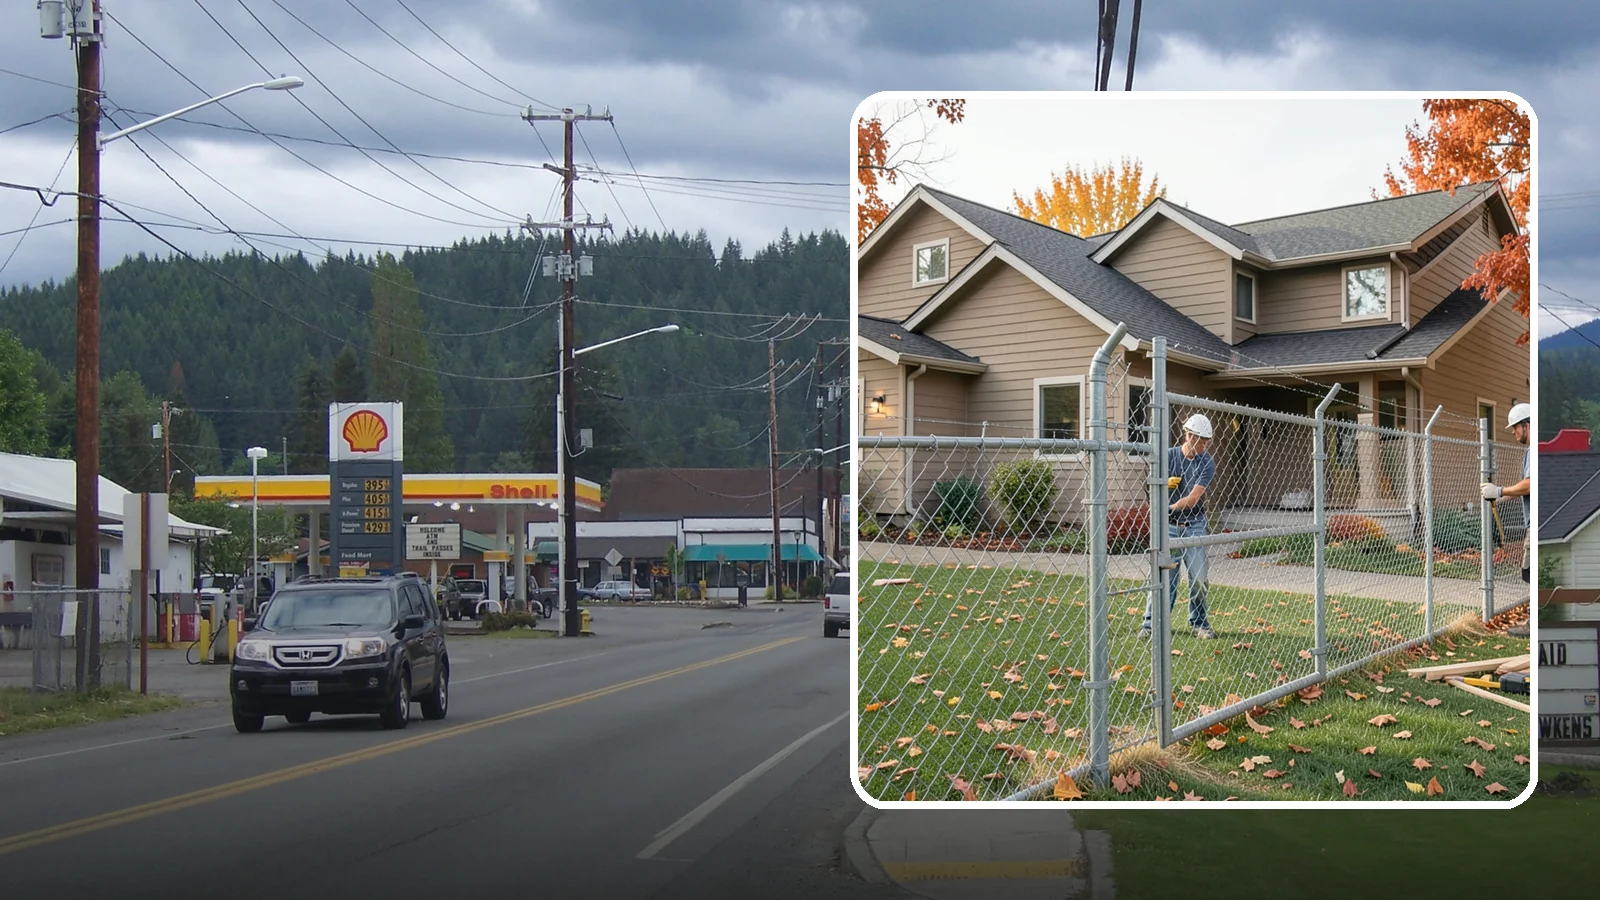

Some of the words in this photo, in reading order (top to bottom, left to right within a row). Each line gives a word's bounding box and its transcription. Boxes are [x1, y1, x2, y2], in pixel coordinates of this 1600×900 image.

[365, 480, 384, 490] 395
[490, 484, 547, 499] Shell
[365, 494, 384, 504] 405
[365, 508, 384, 518] 415
[365, 522, 384, 533] 429
[1538, 643, 1566, 665] AID
